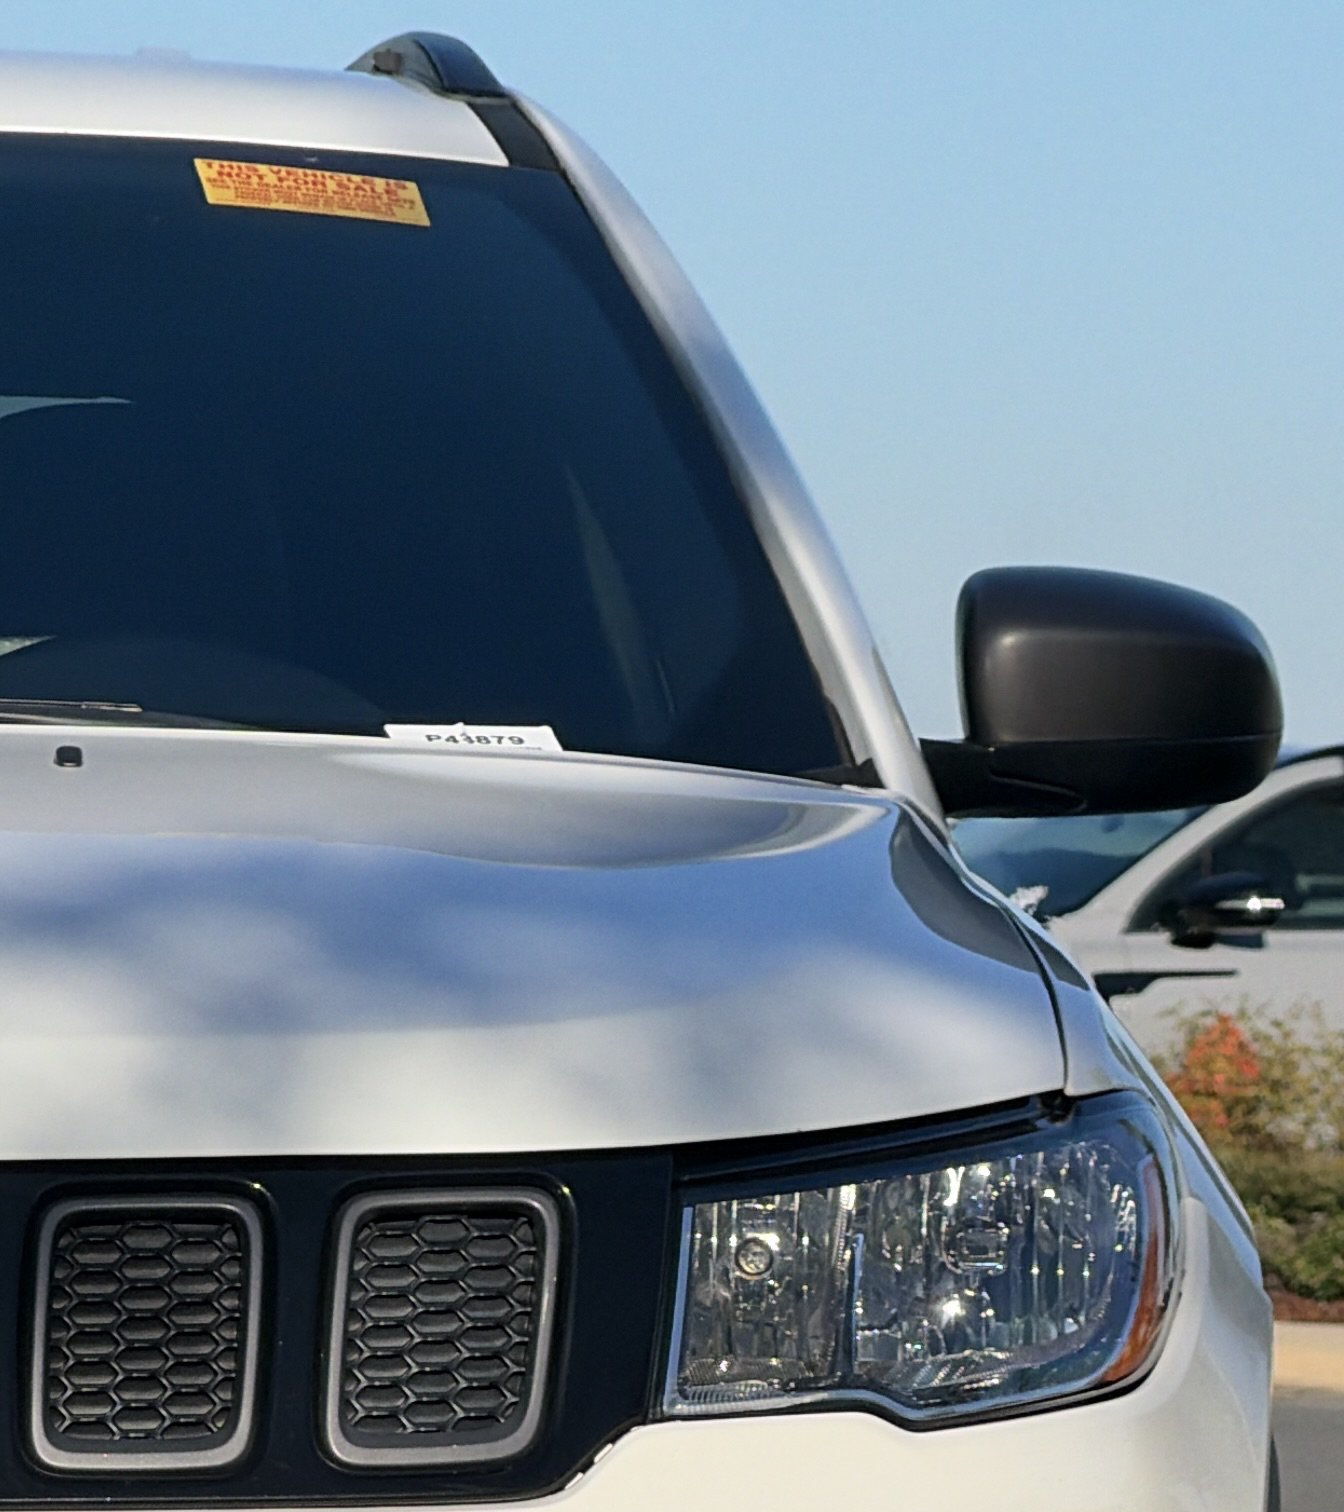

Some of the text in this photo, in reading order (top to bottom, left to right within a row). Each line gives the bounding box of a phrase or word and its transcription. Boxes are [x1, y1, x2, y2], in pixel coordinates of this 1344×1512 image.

[204, 160, 409, 190] THIS VEHICLE IS
[216, 171, 398, 197] NOT FOR SALE
